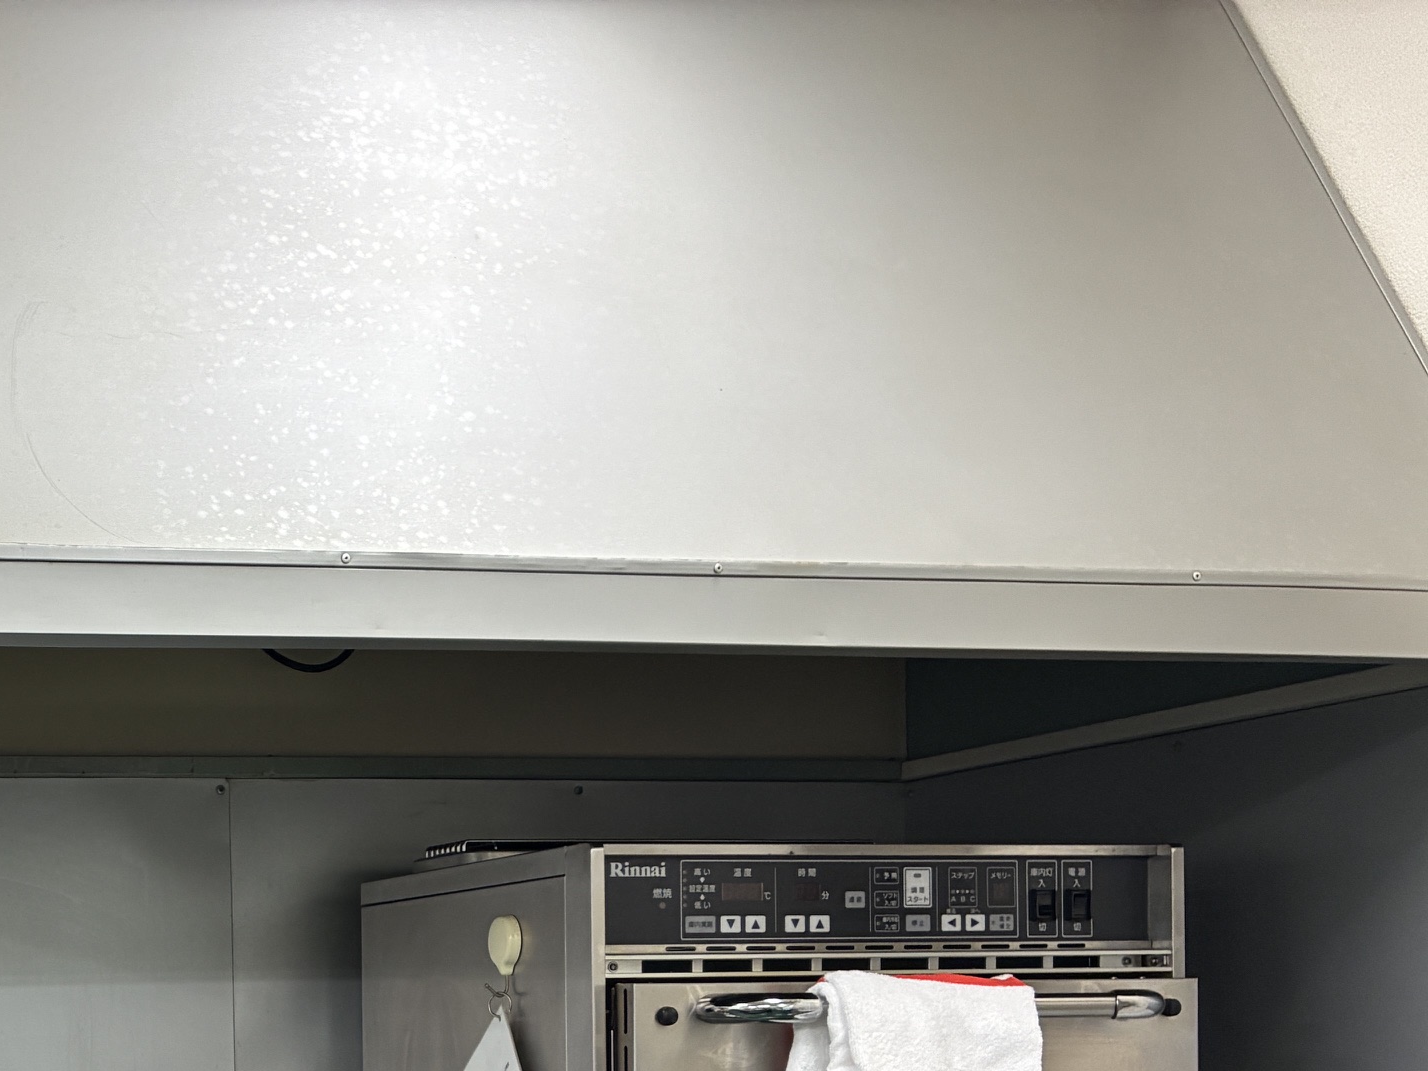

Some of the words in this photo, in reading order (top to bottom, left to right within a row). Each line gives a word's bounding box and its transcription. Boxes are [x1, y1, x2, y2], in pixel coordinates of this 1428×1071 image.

[609, 862, 666, 877] Rinnai
[733, 868, 752, 877] 温度
[797, 868, 817, 877] 時間
[1030, 868, 1053, 877] 庫内灯
[1068, 868, 1086, 876] 電源
[1038, 879, 1045, 887] 入
[1073, 879, 1080, 887] 入
[653, 888, 672, 899] 燃焼
[821, 891, 829, 900] 分
[1039, 923, 1046, 931] 切
[1074, 923, 1081, 931] 切
